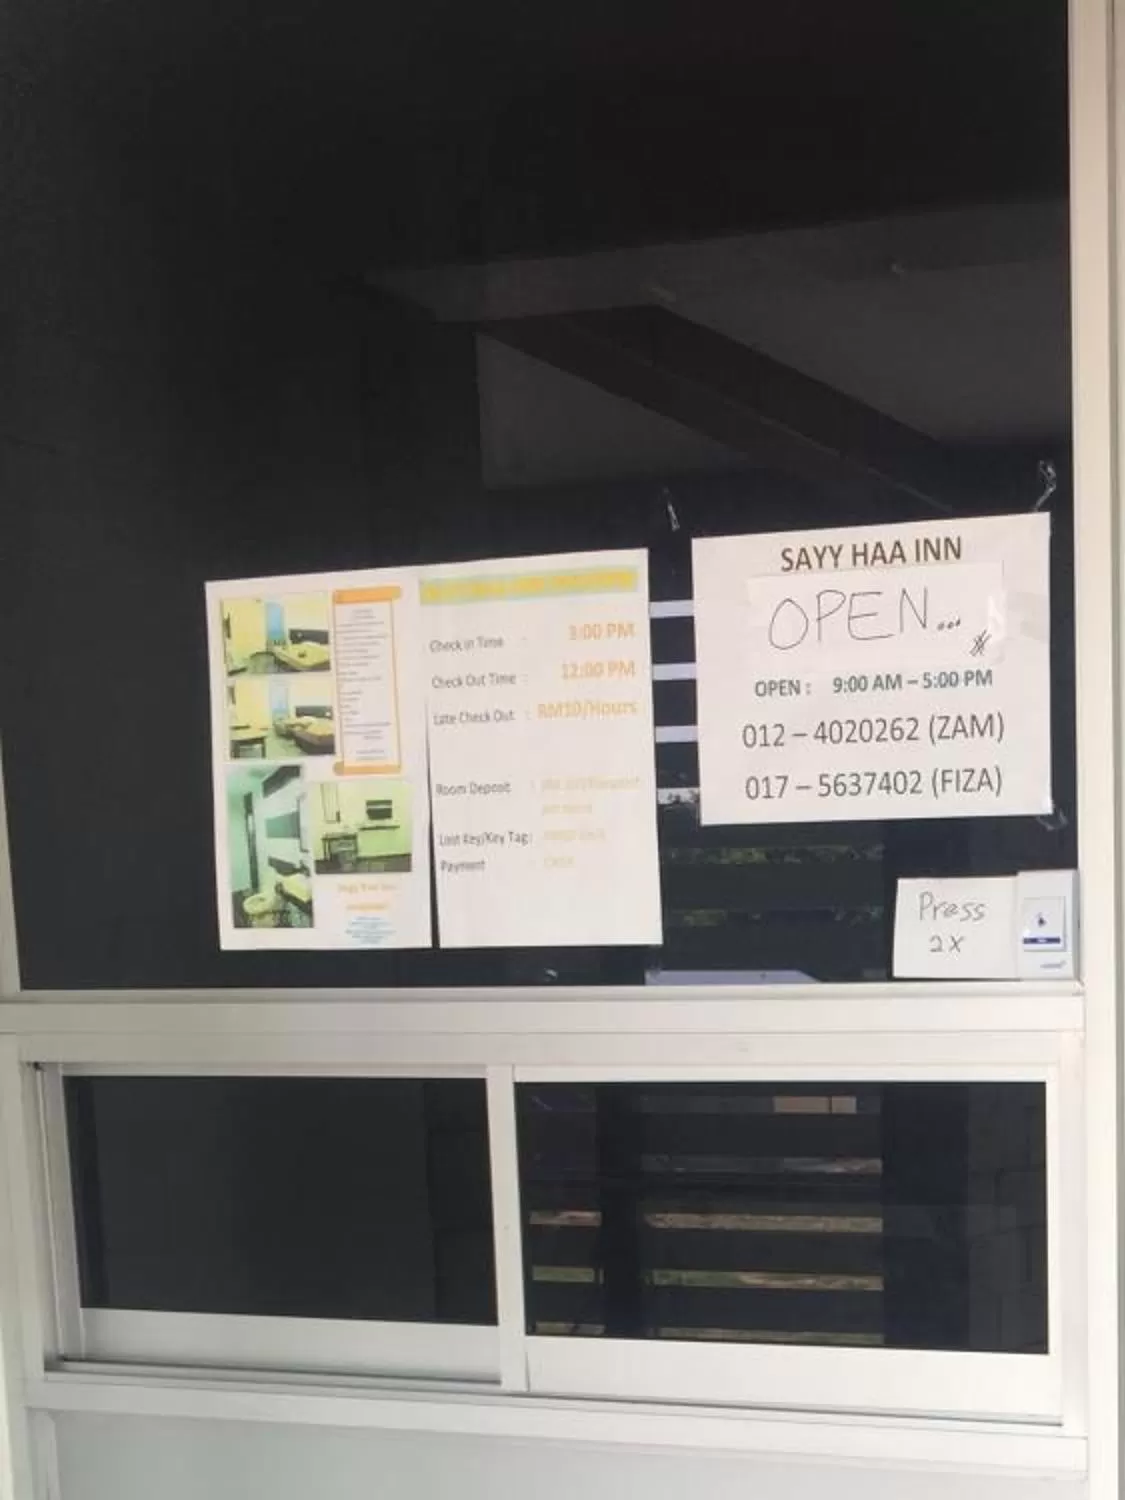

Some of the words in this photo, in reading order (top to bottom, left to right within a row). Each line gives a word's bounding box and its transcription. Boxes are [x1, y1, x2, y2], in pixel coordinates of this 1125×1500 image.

[780, 544, 843, 572] SAYY
[851, 540, 907, 567] HAA
[914, 535, 961, 562] INN
[754, 680, 801, 698] OPEN
[832, 677, 868, 694] 9:00
[872, 674, 903, 691] AM
[923, 671, 959, 690] 5:00
[963, 669, 993, 687] PM
[742, 724, 785, 749] 012
[813, 717, 920, 745] 4020262
[928, 711, 1004, 745] (ZAM)
[745, 776, 789, 800] 017
[818, 770, 923, 797] 5637402
[931, 765, 1002, 799] (FIZA)
[918, 891, 986, 921] Press
